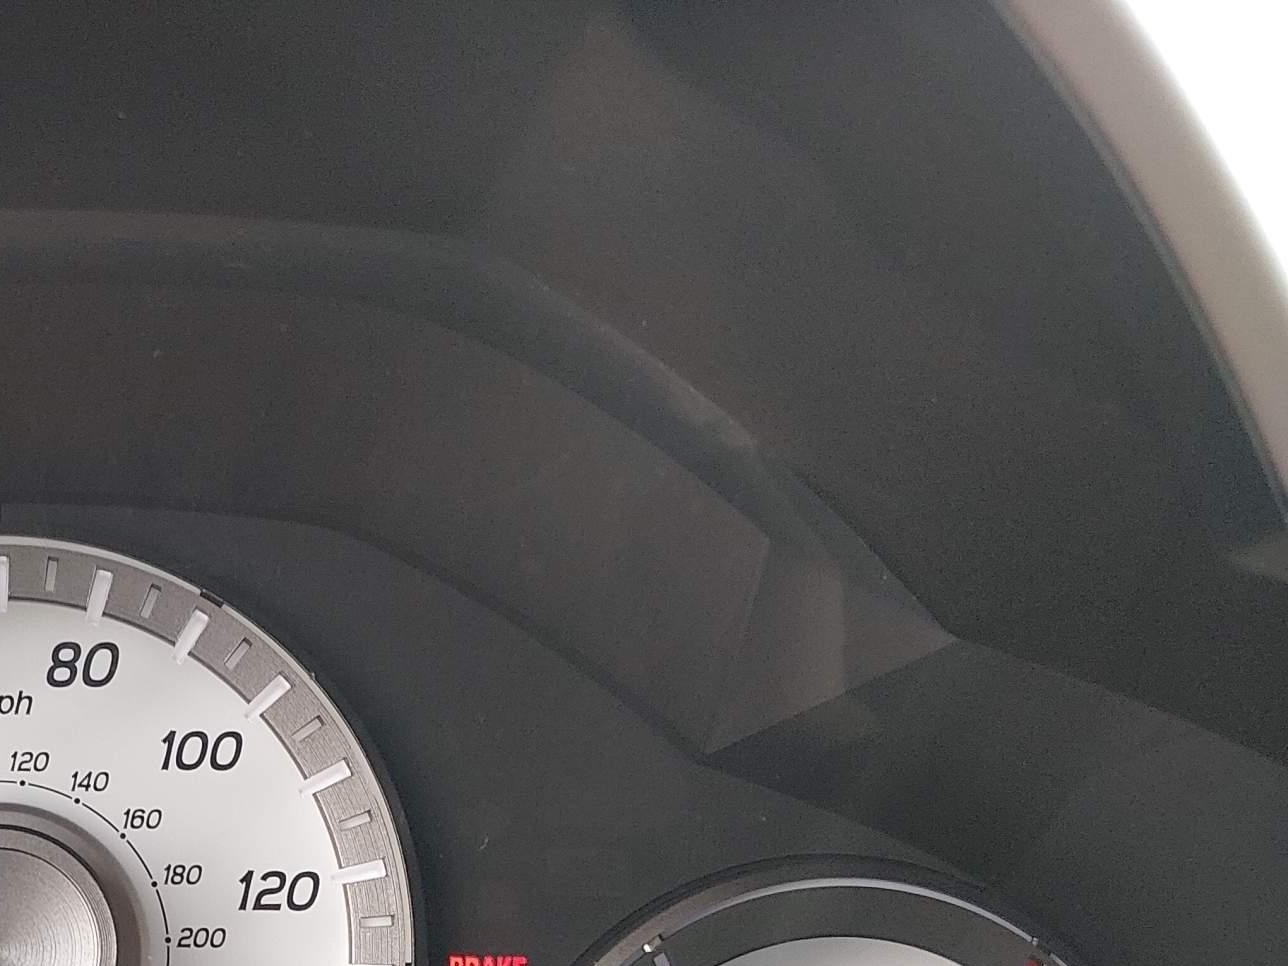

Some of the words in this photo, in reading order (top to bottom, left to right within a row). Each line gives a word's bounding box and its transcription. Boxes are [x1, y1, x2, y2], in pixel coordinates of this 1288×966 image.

[47, 642, 119, 687] 80
[162, 730, 242, 770] 100
[11, 751, 50, 772] 120
[72, 771, 110, 792] 140
[123, 808, 162, 830] 160
[164, 863, 202, 886] 180
[239, 870, 320, 912] 120
[176, 927, 226, 949] 200
